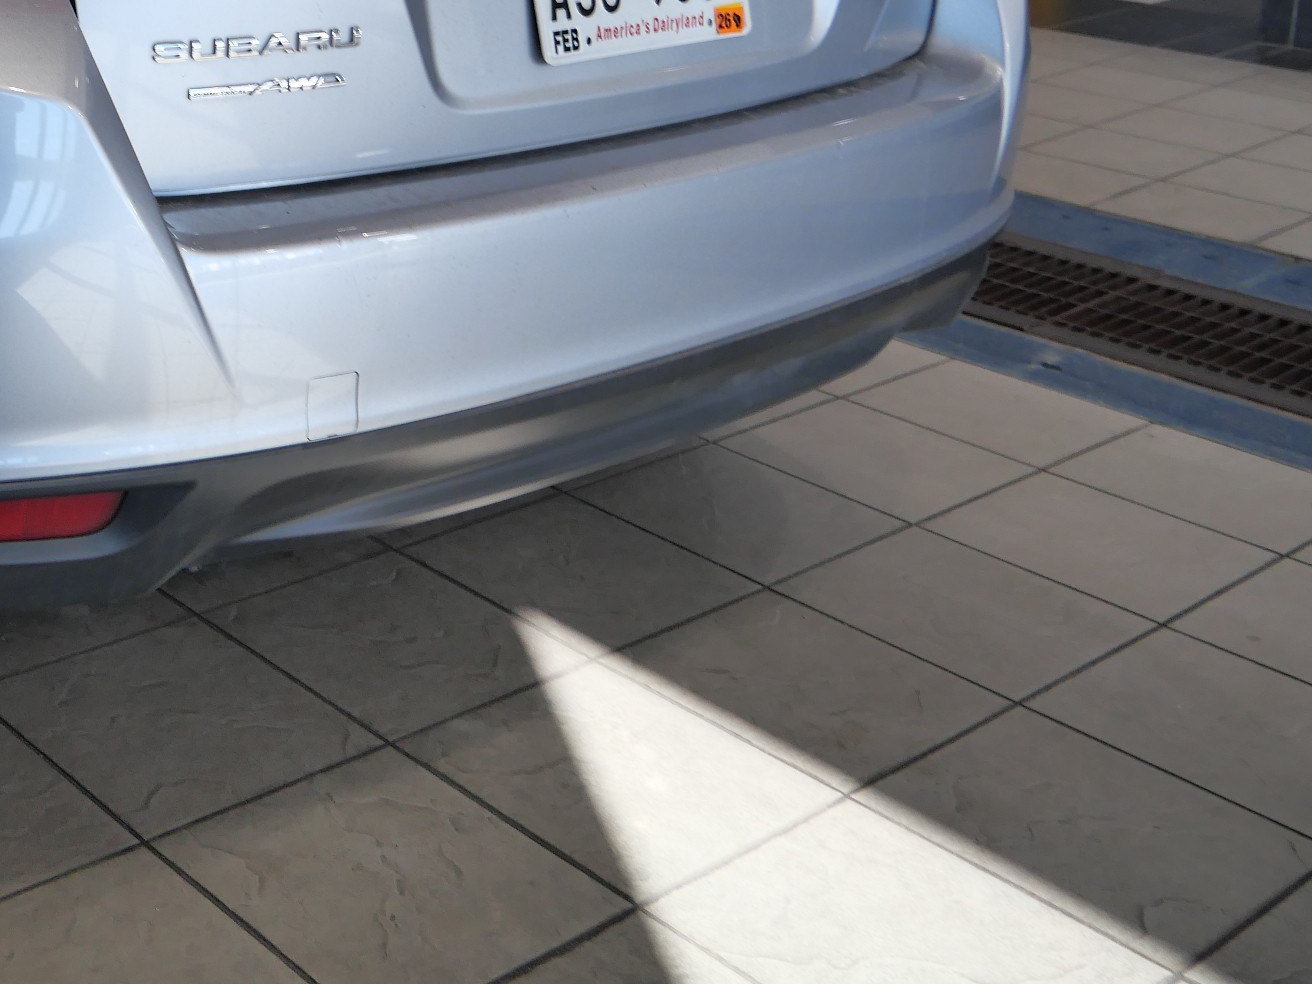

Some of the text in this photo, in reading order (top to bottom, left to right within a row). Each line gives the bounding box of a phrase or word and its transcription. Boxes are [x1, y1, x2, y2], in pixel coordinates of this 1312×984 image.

[552, 27, 581, 55] FEB
[595, 11, 705, 42] America's Dairyland
[152, 25, 364, 64] SUBARU
[249, 71, 348, 97] AWD
